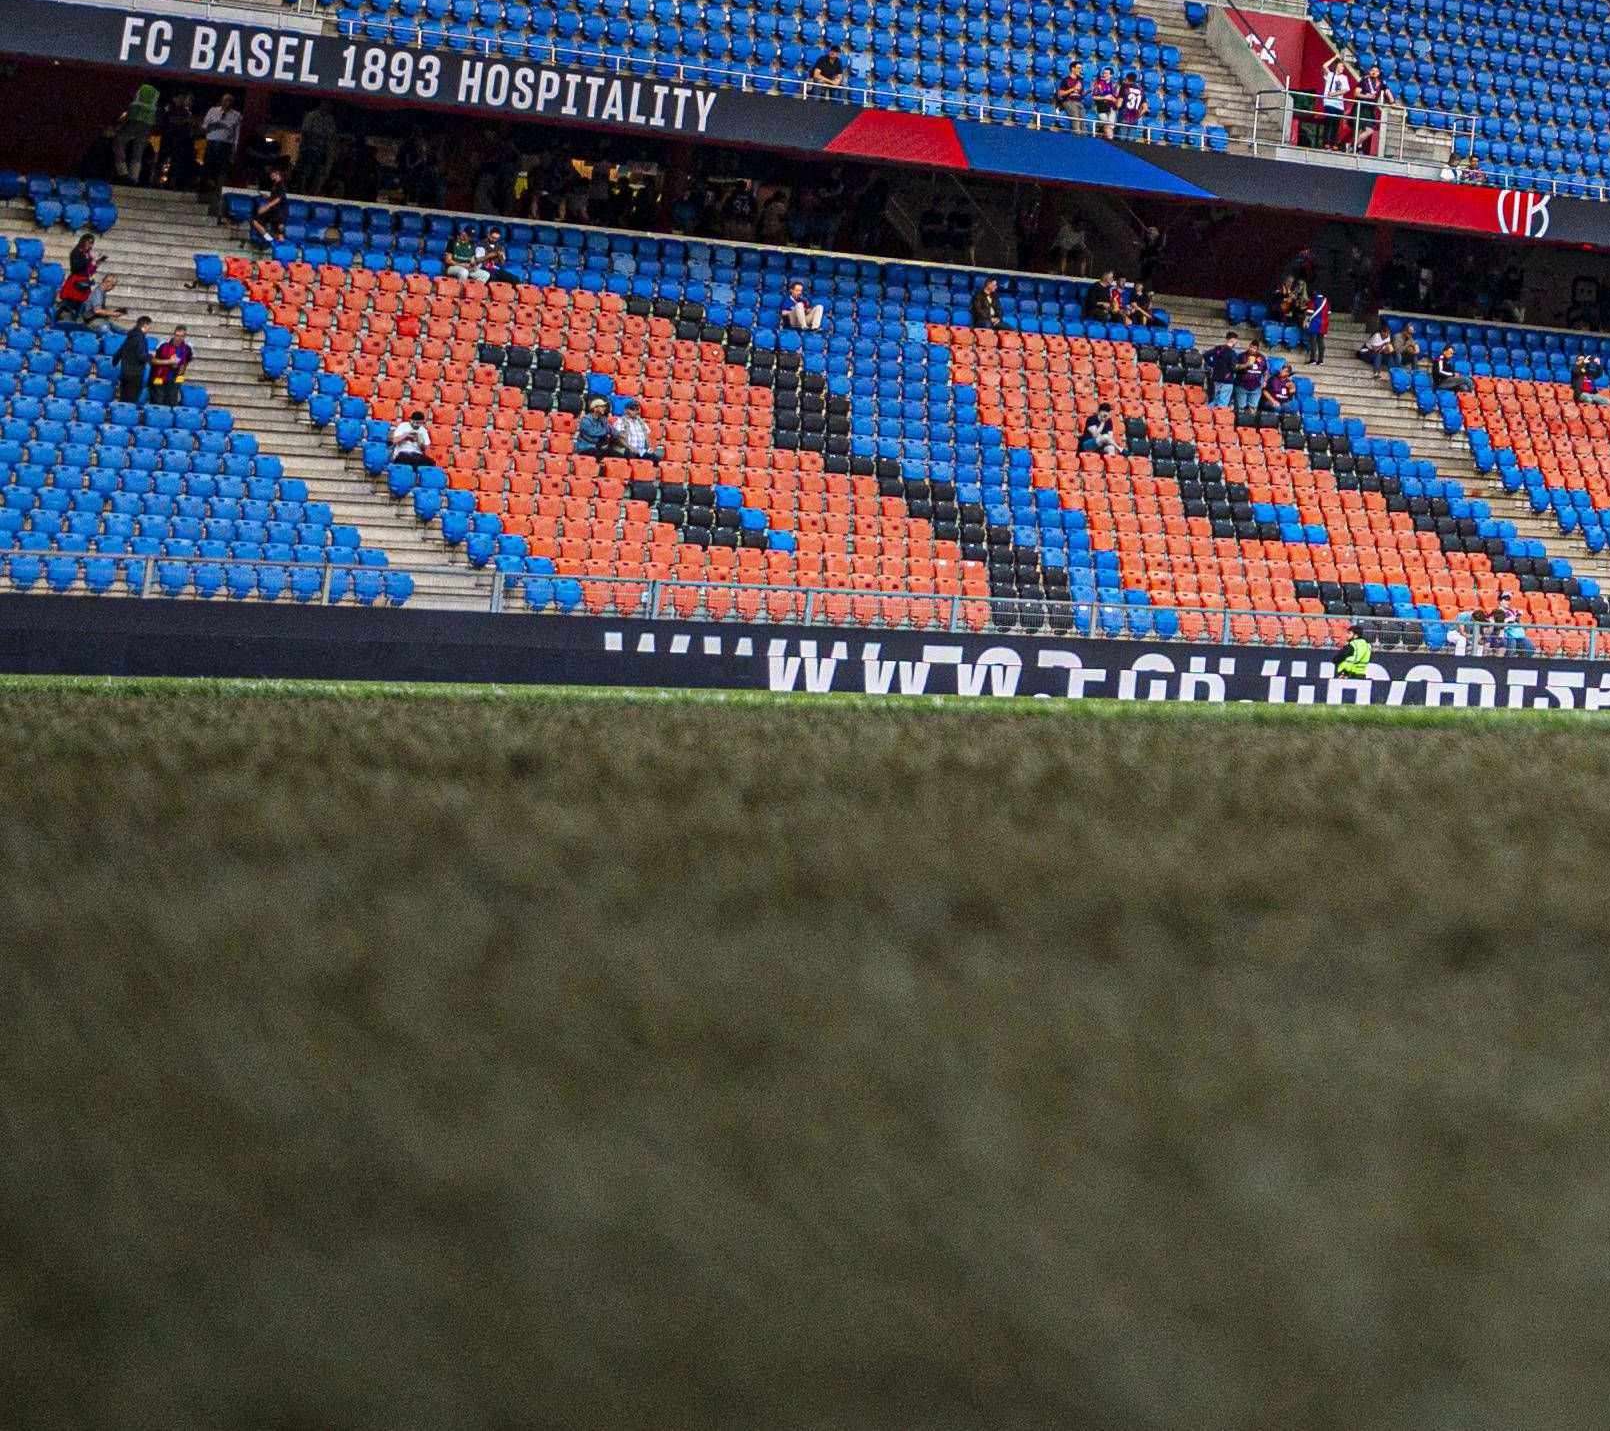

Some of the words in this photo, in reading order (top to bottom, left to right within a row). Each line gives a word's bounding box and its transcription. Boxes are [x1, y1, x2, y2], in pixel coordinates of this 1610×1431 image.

[117, 15, 174, 66] FC
[189, 25, 321, 85] BASEL
[337, 44, 442, 100] 1893
[456, 59, 718, 134] HOSPITALITY
[1126, 93, 1143, 111] 31
